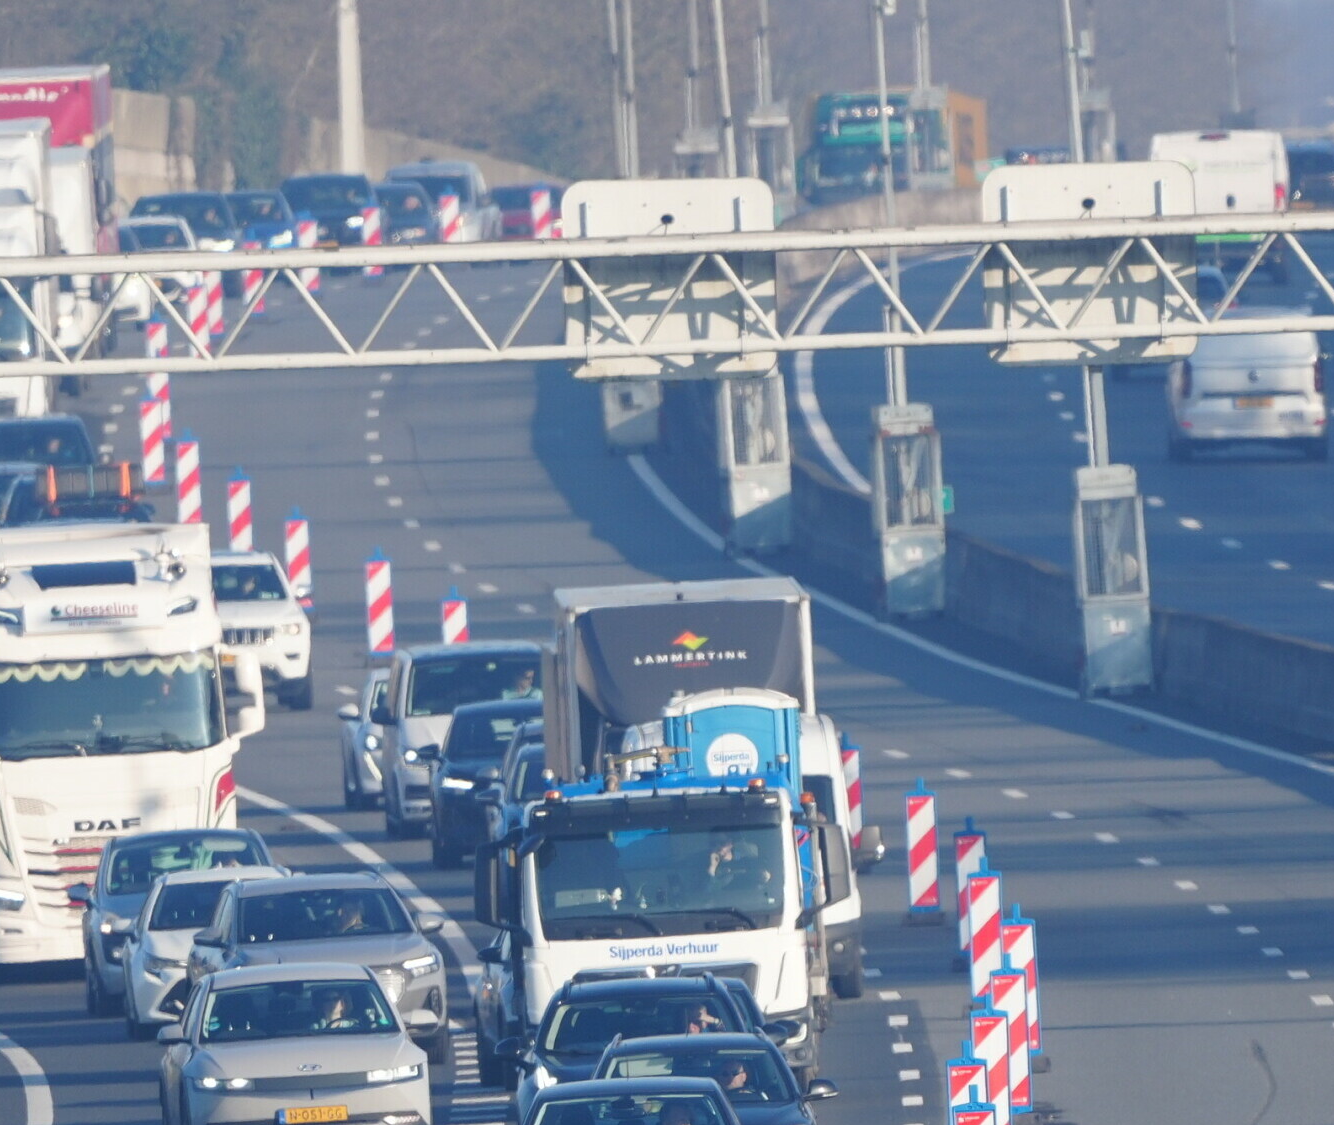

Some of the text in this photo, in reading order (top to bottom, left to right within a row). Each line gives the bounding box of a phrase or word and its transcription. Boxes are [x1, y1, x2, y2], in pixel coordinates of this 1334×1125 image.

[65, 602, 139, 617] Cheeseline
[634, 649, 747, 666] LAMMERTINK
[74, 817, 141, 832] DAF
[609, 940, 719, 960] Sijperda Verhuur
